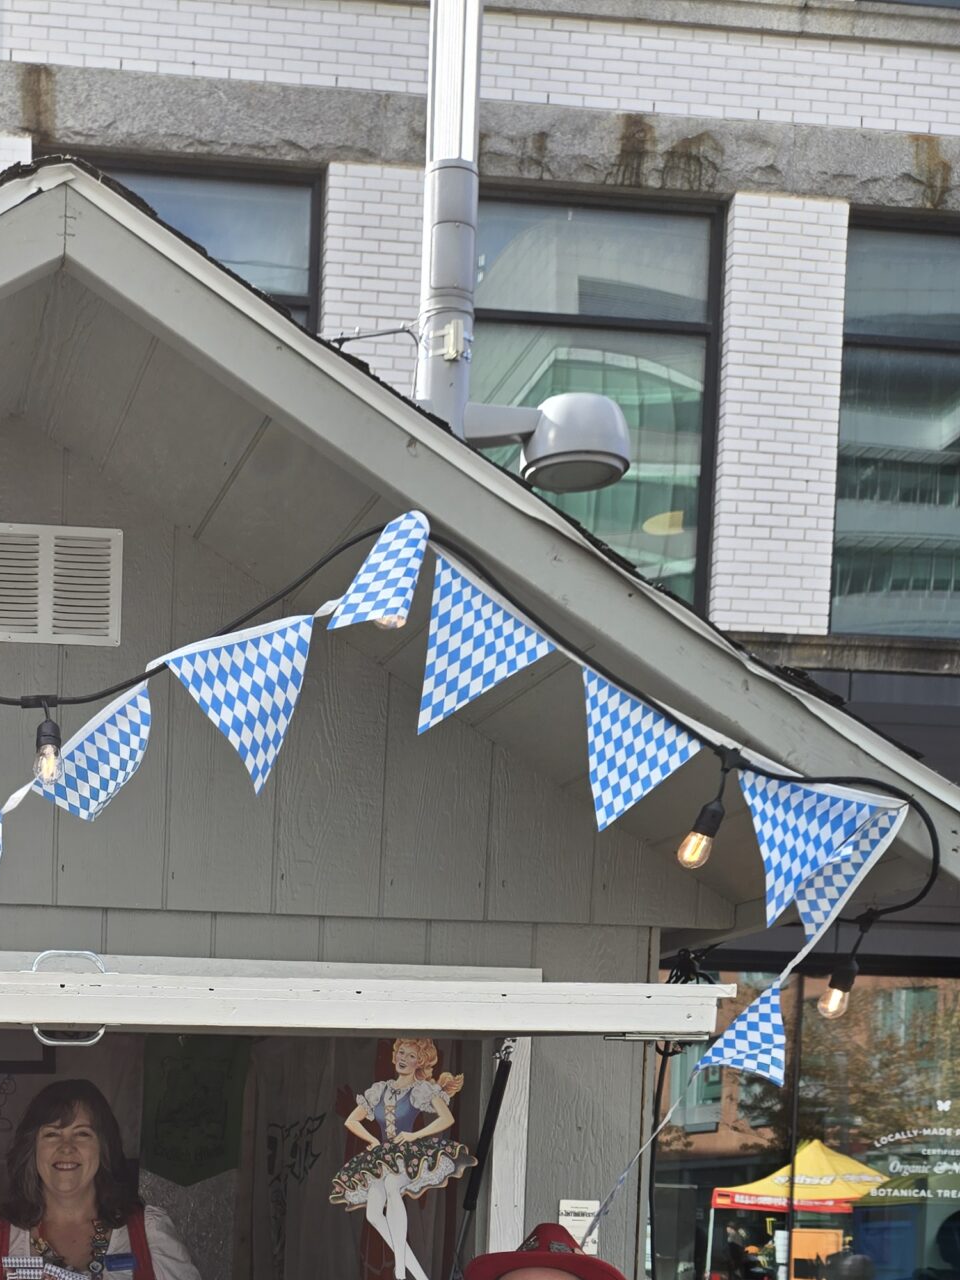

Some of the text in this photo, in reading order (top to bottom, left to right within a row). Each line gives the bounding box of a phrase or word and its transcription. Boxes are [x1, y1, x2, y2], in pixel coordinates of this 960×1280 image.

[873, 1127, 954, 1148] LOCALLY-MADE
[888, 1160, 931, 1177] Organic
[870, 1188, 934, 1198] BOTANICAL
